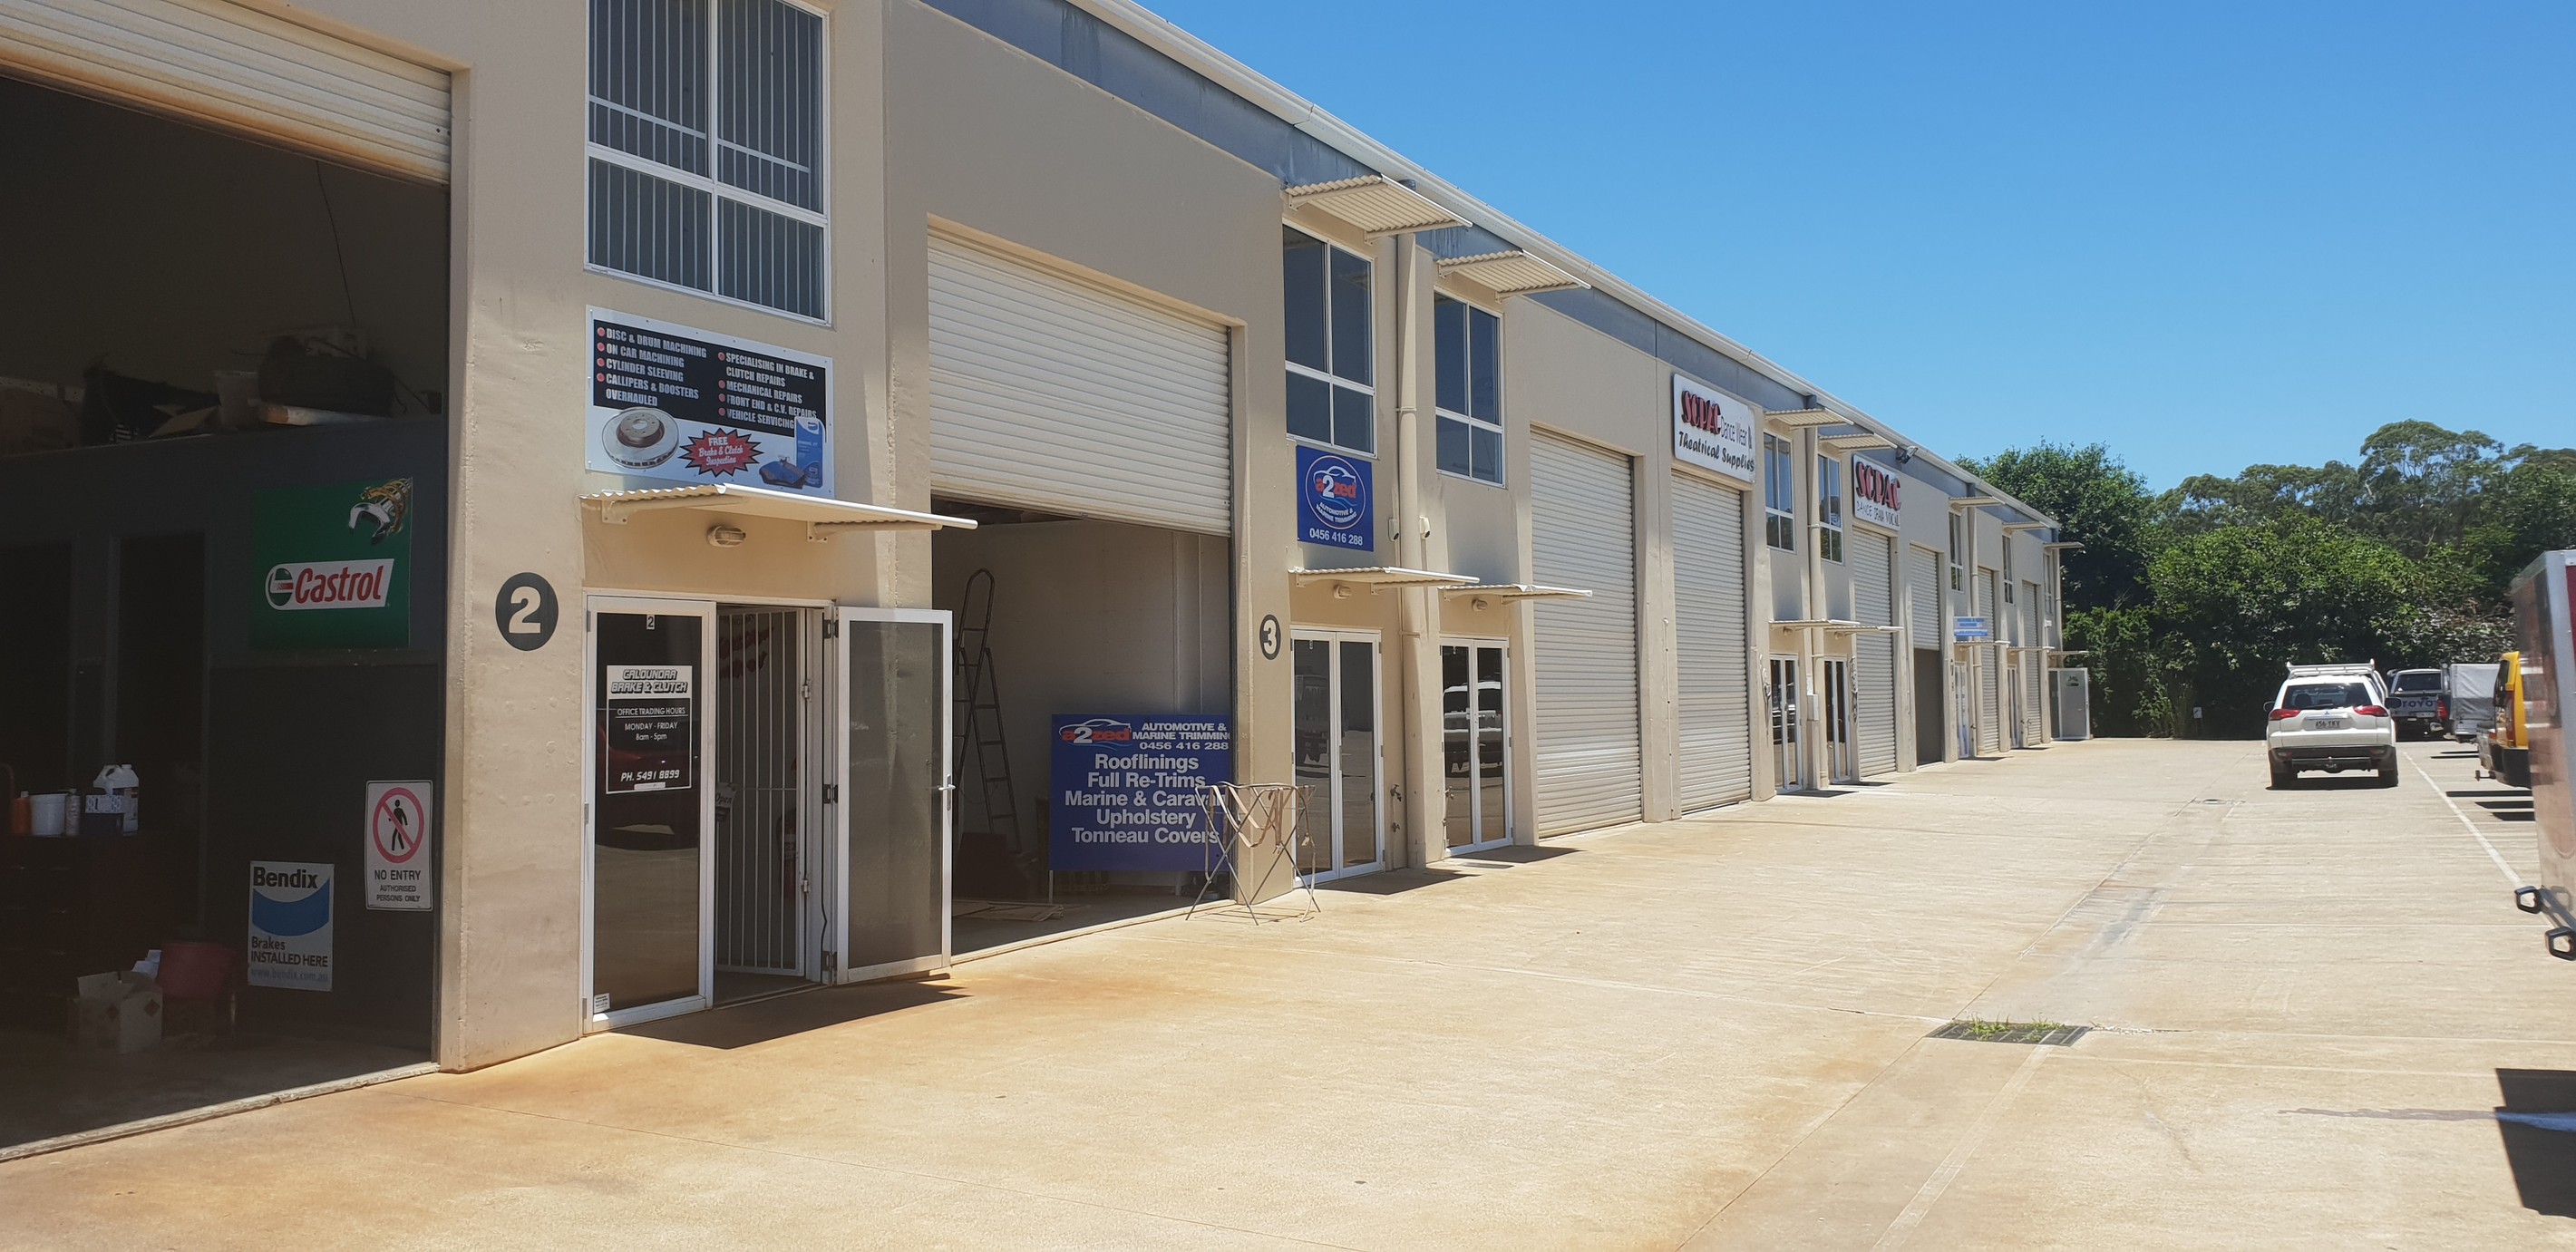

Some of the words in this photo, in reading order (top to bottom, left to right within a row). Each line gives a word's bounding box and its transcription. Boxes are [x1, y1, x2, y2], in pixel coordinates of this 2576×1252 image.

[607, 328, 627, 342] DISC
[628, 334, 635, 344] &
[637, 335, 661, 349] DRUM
[663, 339, 707, 358] MACHINING
[607, 344, 617, 354] ON
[620, 346, 637, 359] CAR
[639, 349, 685, 368] MACHINING
[606, 358, 646, 375] CYLINDER
[647, 365, 684, 382] SLEEVING
[726, 353, 774, 372] SPECIALISING
[776, 363, 783, 374] IN
[785, 364, 808, 379] BRAKE
[809, 372, 814, 380] &
[726, 366, 754, 381] CLUTCH
[756, 373, 785, 387] REPAIRS
[606, 374, 649, 390] CALLIPERS
[651, 383, 657, 392] &
[659, 383, 699, 399] BOOSTERS
[726, 381, 773, 398] MECHANICAL
[773, 389, 802, 404] REPAIRS
[606, 388, 657, 406] OVERHAULED
[726, 394, 750, 408] FRONT
[752, 399, 765, 411] END
[767, 403, 773, 412] &
[774, 403, 787, 414] C.V.
[789, 406, 817, 418] REPAIRS
[726, 408, 756, 422] VEHICLE
[757, 413, 794, 429] SERVICING
[1681, 391, 1721, 434] SCPAC
[708, 436, 729, 447] FREE
[698, 447, 717, 458] Brake
[718, 446, 724, 455] &
[724, 444, 744, 455] Clutch
[1678, 431, 1720, 460] Theatrical
[1722, 447, 1755, 472] Supplies
[705, 456, 737, 467] Inspection
[1316, 475, 1356, 499] a2zed
[1855, 461, 1901, 511] SCPAC
[1316, 503, 1334, 522] MARINE
[1335, 510, 1357, 523] TRIMMING
[1319, 501, 1349, 516] AUTOMOTIVE
[1309, 528, 1330, 540] 0456
[1332, 531, 1346, 543] 416
[1348, 534, 1363, 546] 288
[296, 565, 384, 604] Castrol
[509, 586, 541, 634] 2
[647, 616, 654, 627] 2
[1263, 619, 1277, 655] 3
[623, 669, 677, 681] CALOUNDRA
[611, 682, 643, 694] BRAKE
[644, 682, 652, 694] &
[652, 682, 688, 694] CLUTCH
[617, 708, 638, 716] OFFICE
[625, 723, 653, 731] MONDAY
[657, 722, 678, 730] FRIDAY
[1062, 726, 1130, 744] a2zed
[1142, 723, 1215, 732] AUTOMOTIVE
[1218, 723, 1227, 732] &
[654, 733, 667, 742] 5pm
[1132, 732, 1176, 741] MARINE
[1140, 742, 1171, 750] 0456
[1176, 742, 1201, 750] 416
[1204, 742, 1229, 750] 288
[1094, 753, 1200, 773] Rooflinings
[621, 772, 635, 781] PH.
[637, 771, 656, 781] 5491
[659, 770, 680, 779] 8899
[1088, 772, 1120, 788] Full
[1125, 772, 1206, 788] Re-Trims
[1064, 791, 1128, 806] Marine
[1133, 791, 1147, 806] &
[1096, 809, 1196, 829] Upholstery
[1072, 827, 1149, 843] Tonneau
[1154, 827, 1220, 843] Covers
[253, 866, 318, 888] Bendix
[374, 869, 387, 880] NO
[391, 870, 421, 880] ENTRY
[376, 894, 403, 902] PERSONS
[251, 936, 286, 951] Brakes
[251, 950, 301, 966] INSTALLED
[303, 955, 328, 967] HERE
